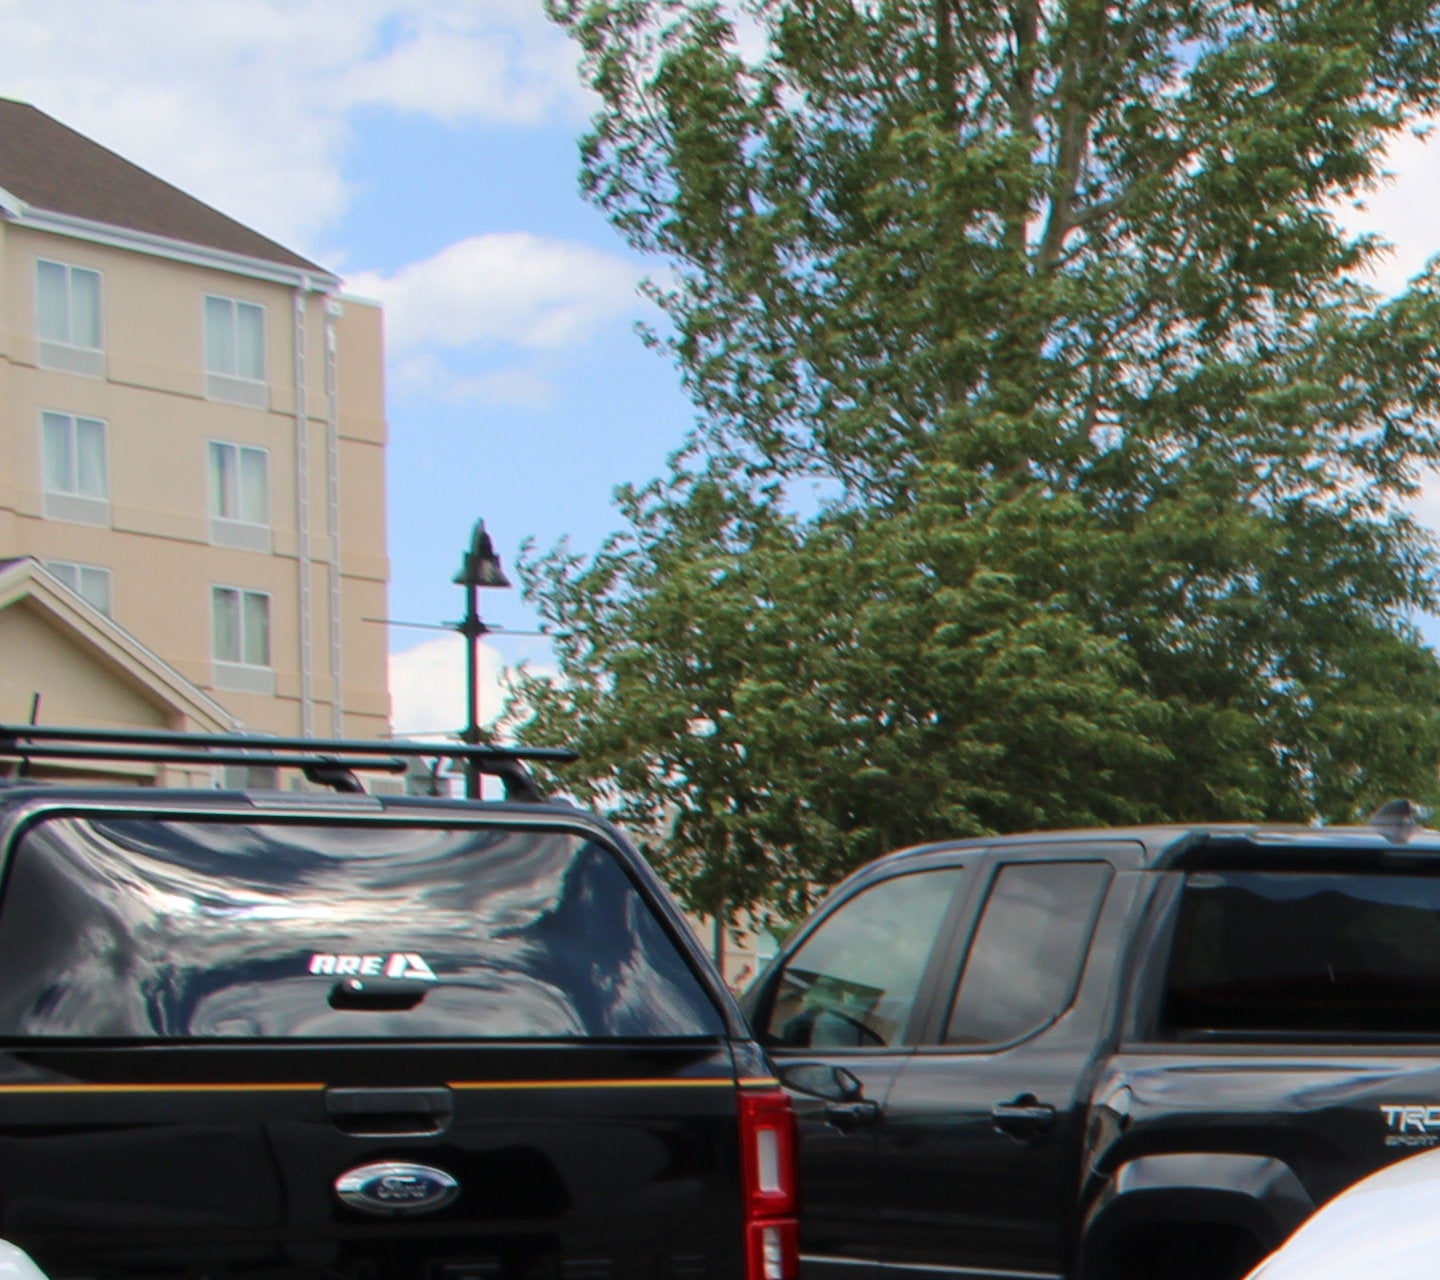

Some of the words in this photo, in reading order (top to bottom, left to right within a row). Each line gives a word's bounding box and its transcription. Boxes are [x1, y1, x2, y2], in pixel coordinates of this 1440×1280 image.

[309, 953, 384, 975] ARE
[1385, 1134, 1438, 1146] SPORT
[377, 1175, 428, 1199] Ford
